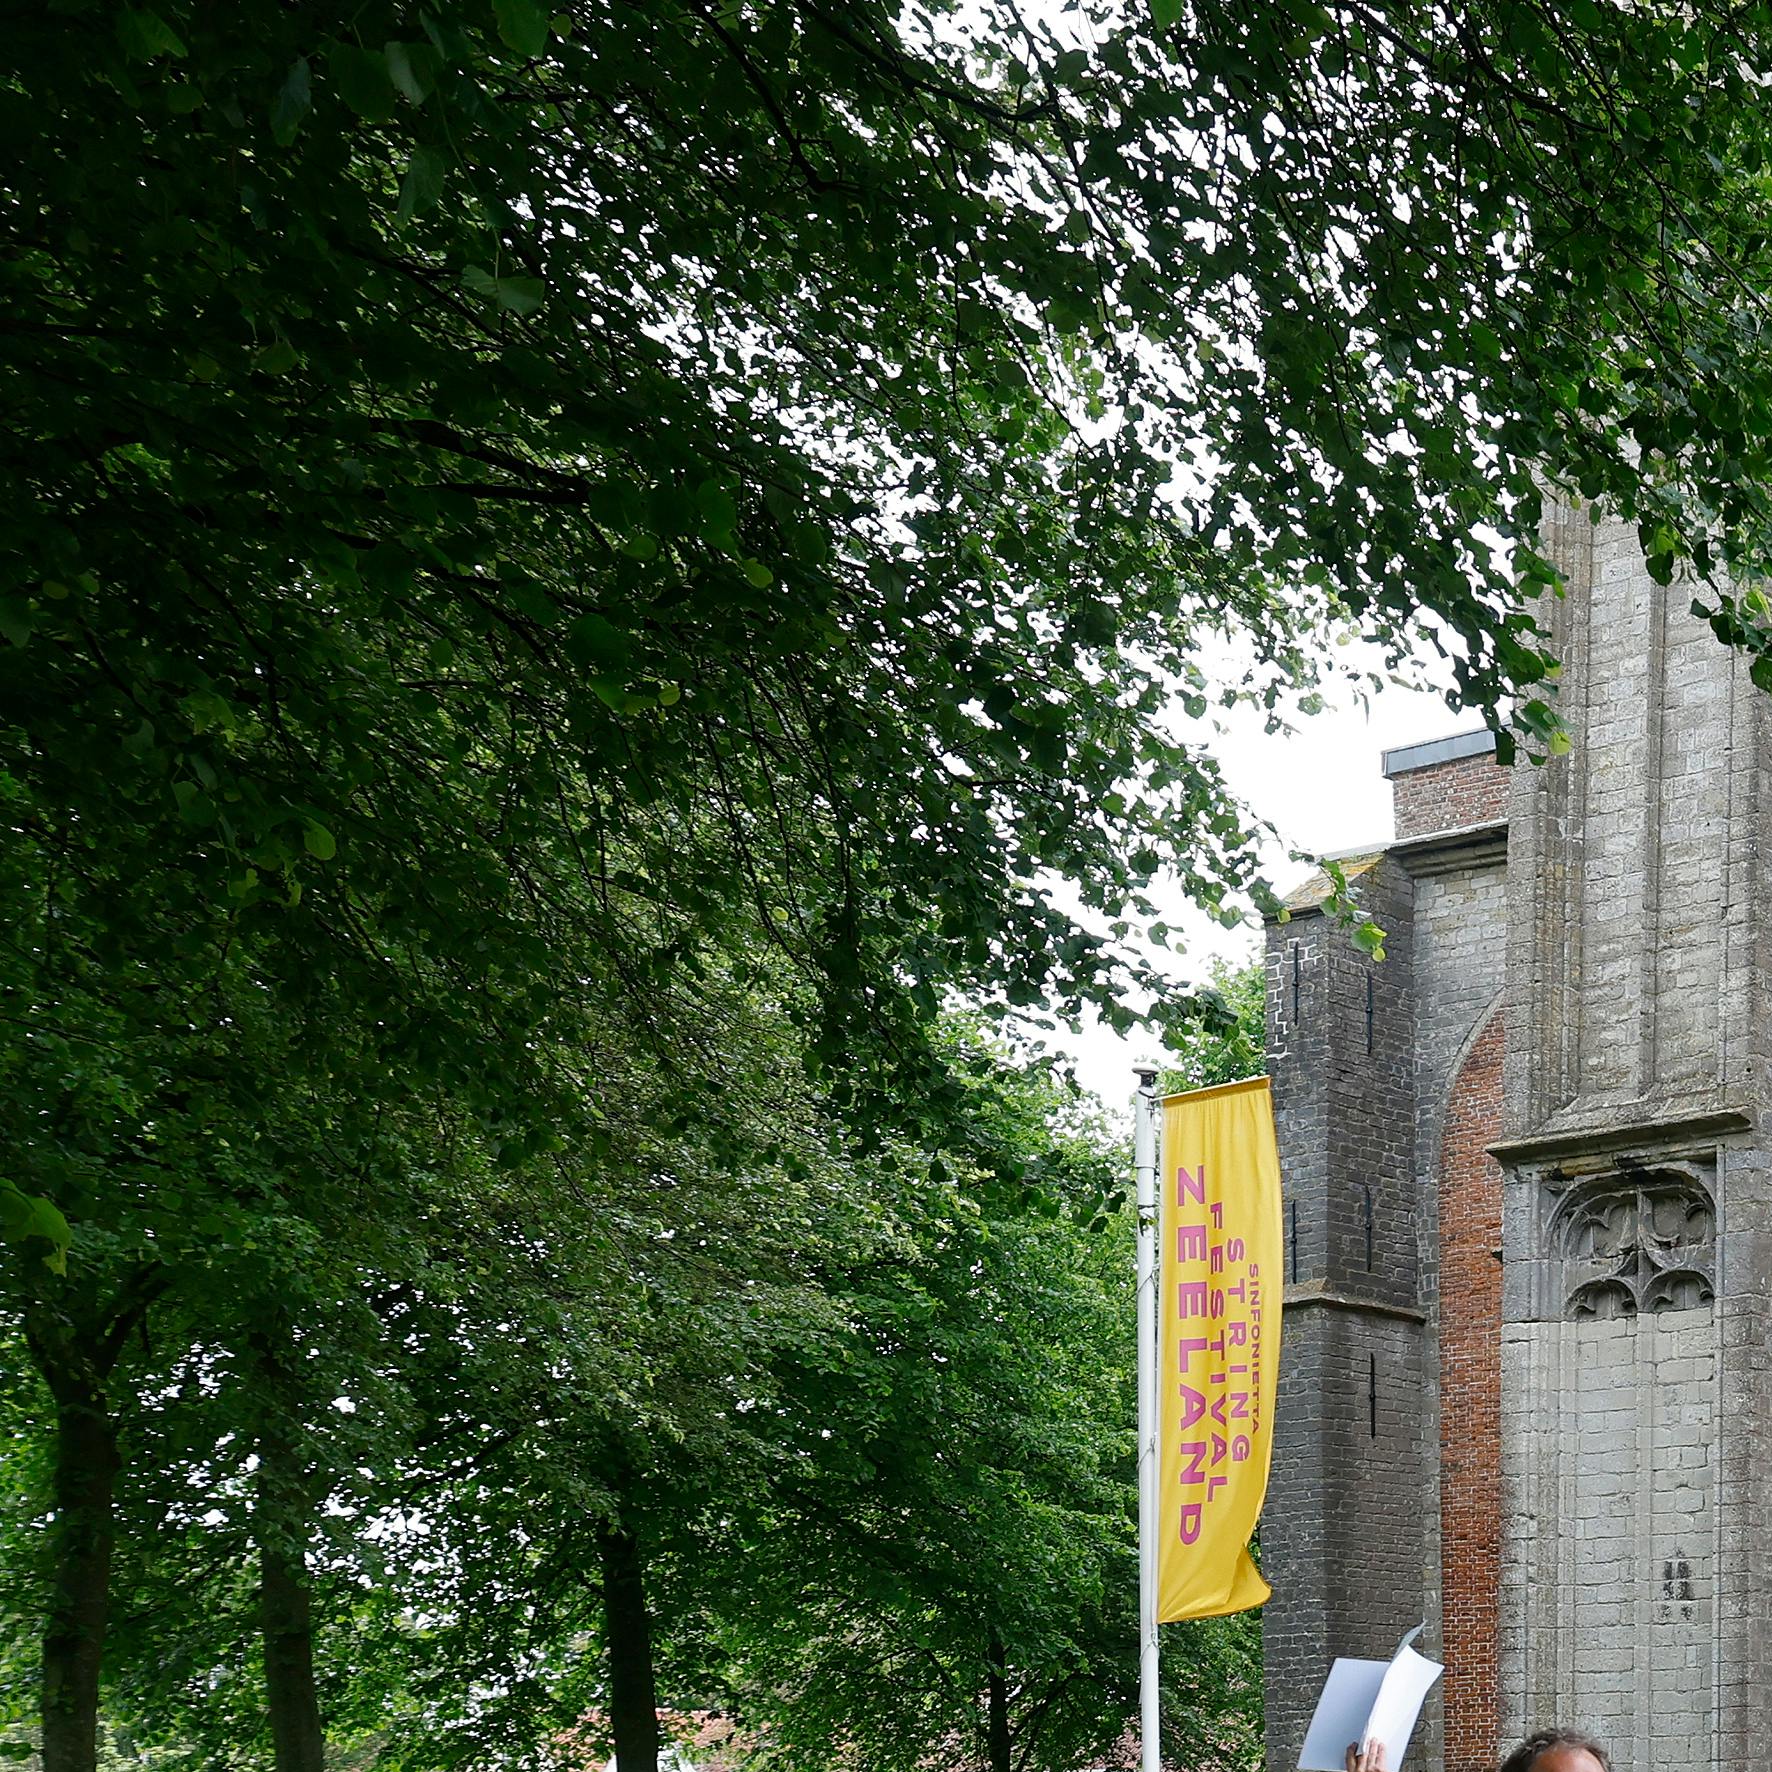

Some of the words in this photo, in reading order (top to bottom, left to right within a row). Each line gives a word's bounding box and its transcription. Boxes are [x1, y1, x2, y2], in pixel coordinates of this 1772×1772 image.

[1176, 1165, 1209, 1546] ZEELAND
[1206, 1202, 1229, 1502] FESTIVAL
[1226, 1237, 1251, 1462] STRING
[1249, 1263, 1261, 1434] SINFONIETTA
